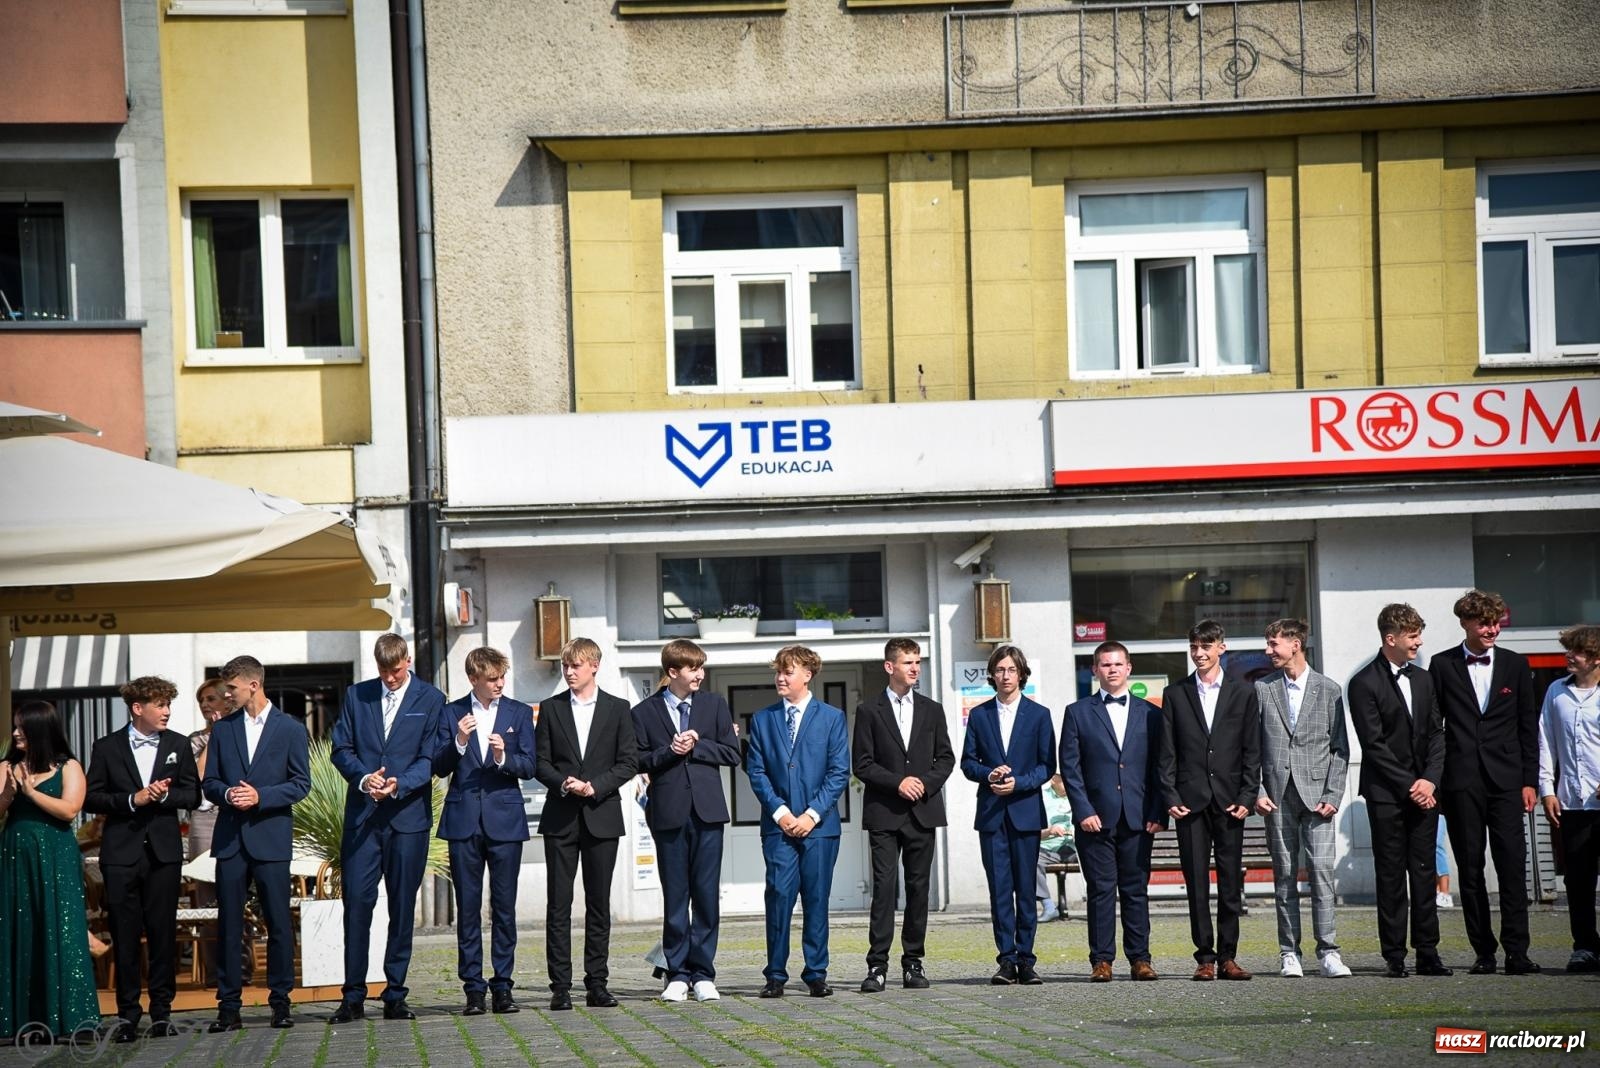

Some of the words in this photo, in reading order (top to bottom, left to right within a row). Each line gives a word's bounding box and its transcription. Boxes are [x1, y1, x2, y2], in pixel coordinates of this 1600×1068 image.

[740, 418, 832, 454] TEB
[1310, 386, 1600, 453] ROSSM
[741, 460, 833, 475] EDUKACJA
